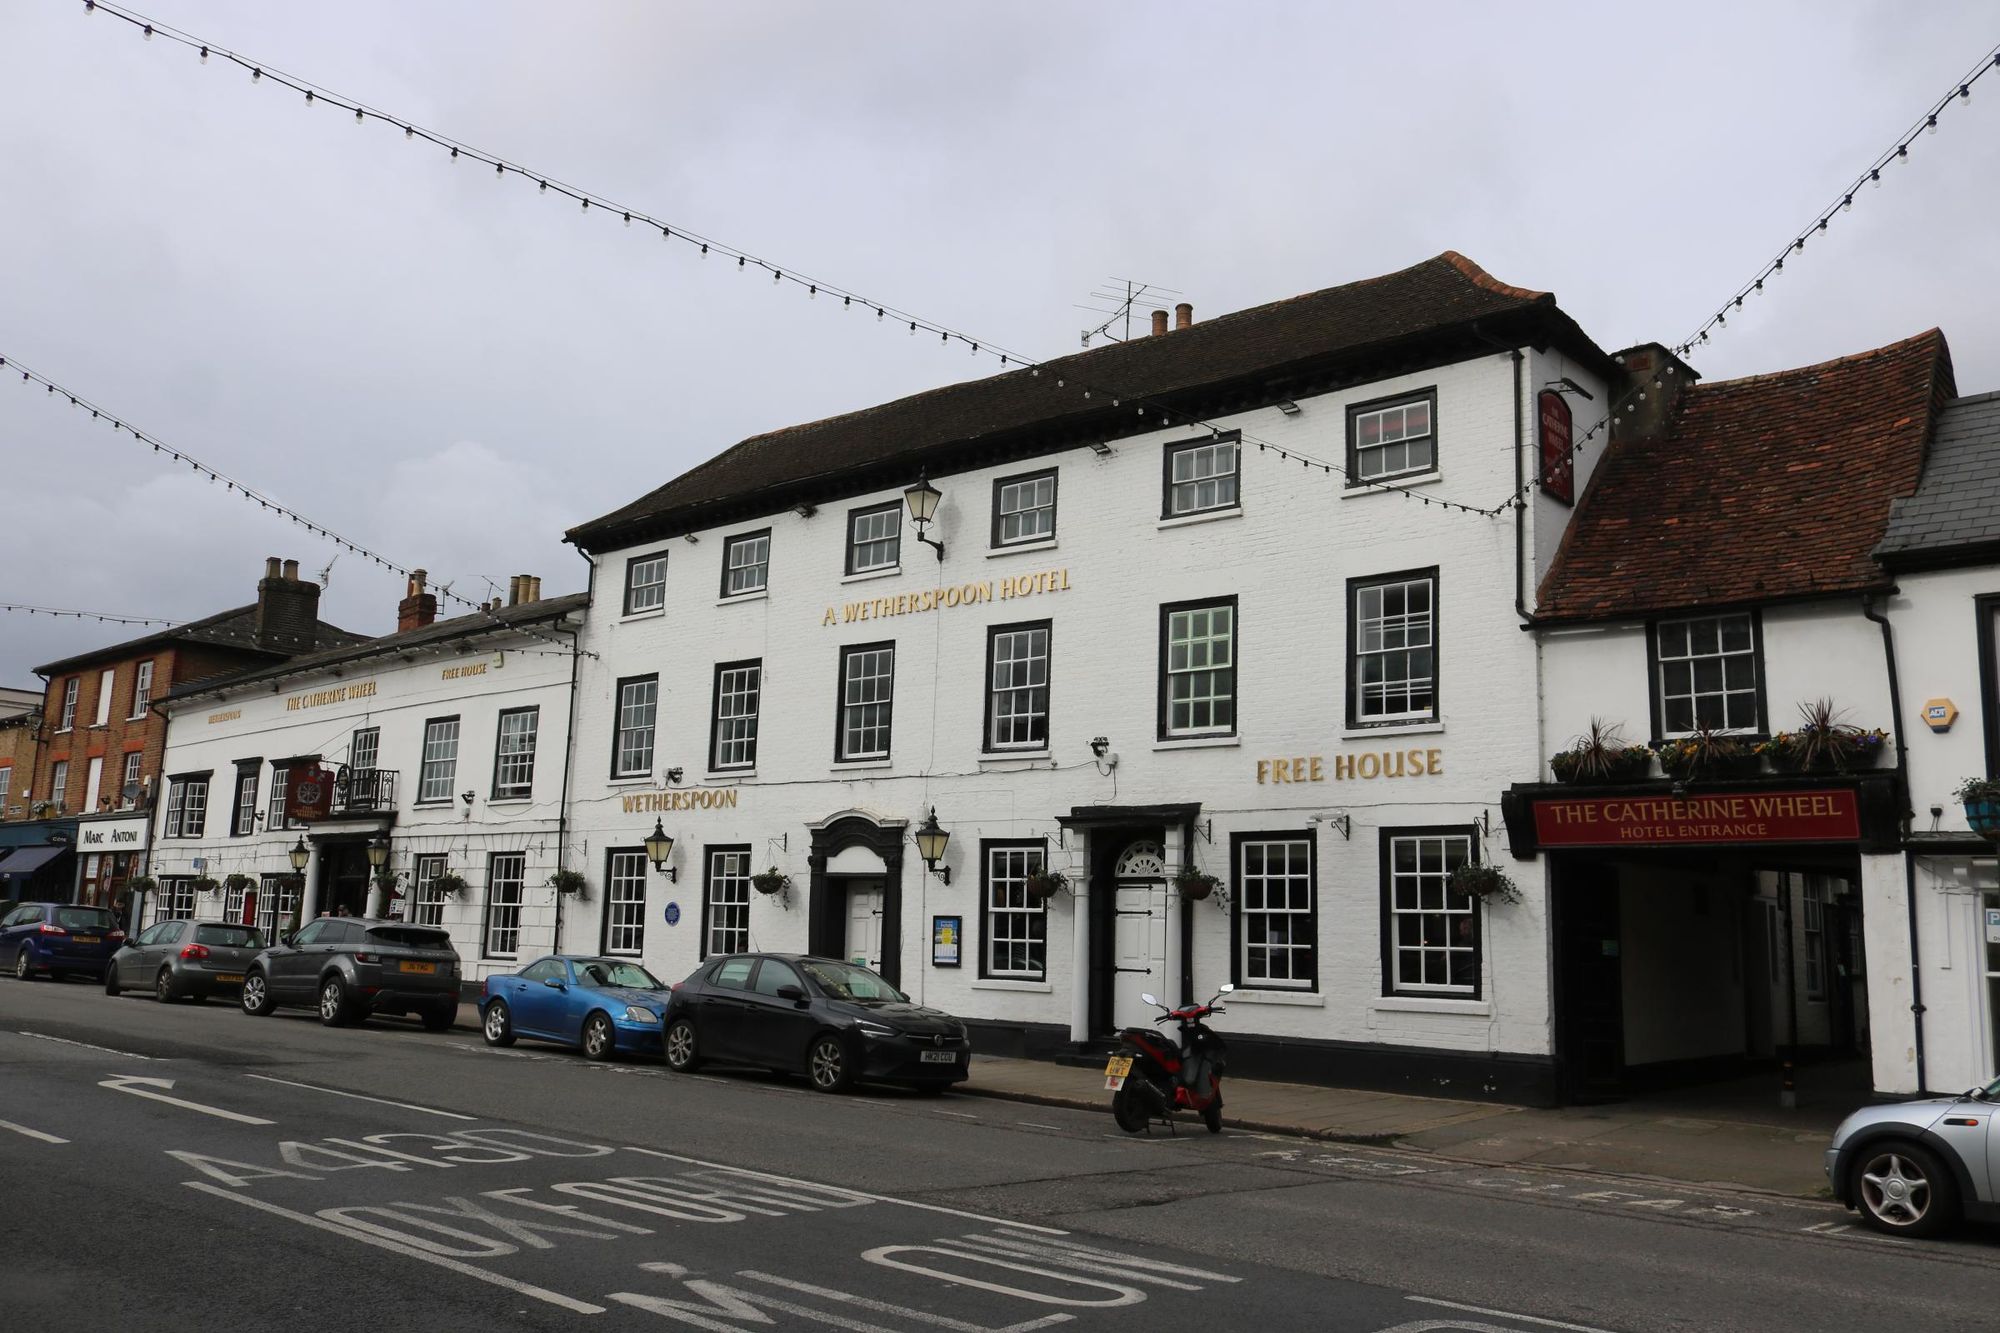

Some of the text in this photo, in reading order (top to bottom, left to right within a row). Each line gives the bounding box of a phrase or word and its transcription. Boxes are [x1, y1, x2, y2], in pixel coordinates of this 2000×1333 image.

[823, 567, 1071, 626] A WETHERSPOON HOTEL
[442, 663, 487, 680] FREE HOUSE
[287, 681, 377, 711] THE CATHERINE WHEEL
[1930, 708, 1945, 716] ADT
[1257, 748, 1443, 785] FREE HOUSE
[622, 789, 738, 813] WETHERSPOON
[1551, 796, 1842, 824] THE CATHERINE WHEEL
[83, 828, 137, 845] MARC ANTONI
[1620, 823, 1767, 838] HOTEL ENTRANCE
[164, 1129, 616, 1187] A4130
[315, 1170, 877, 1258] OXFORD
